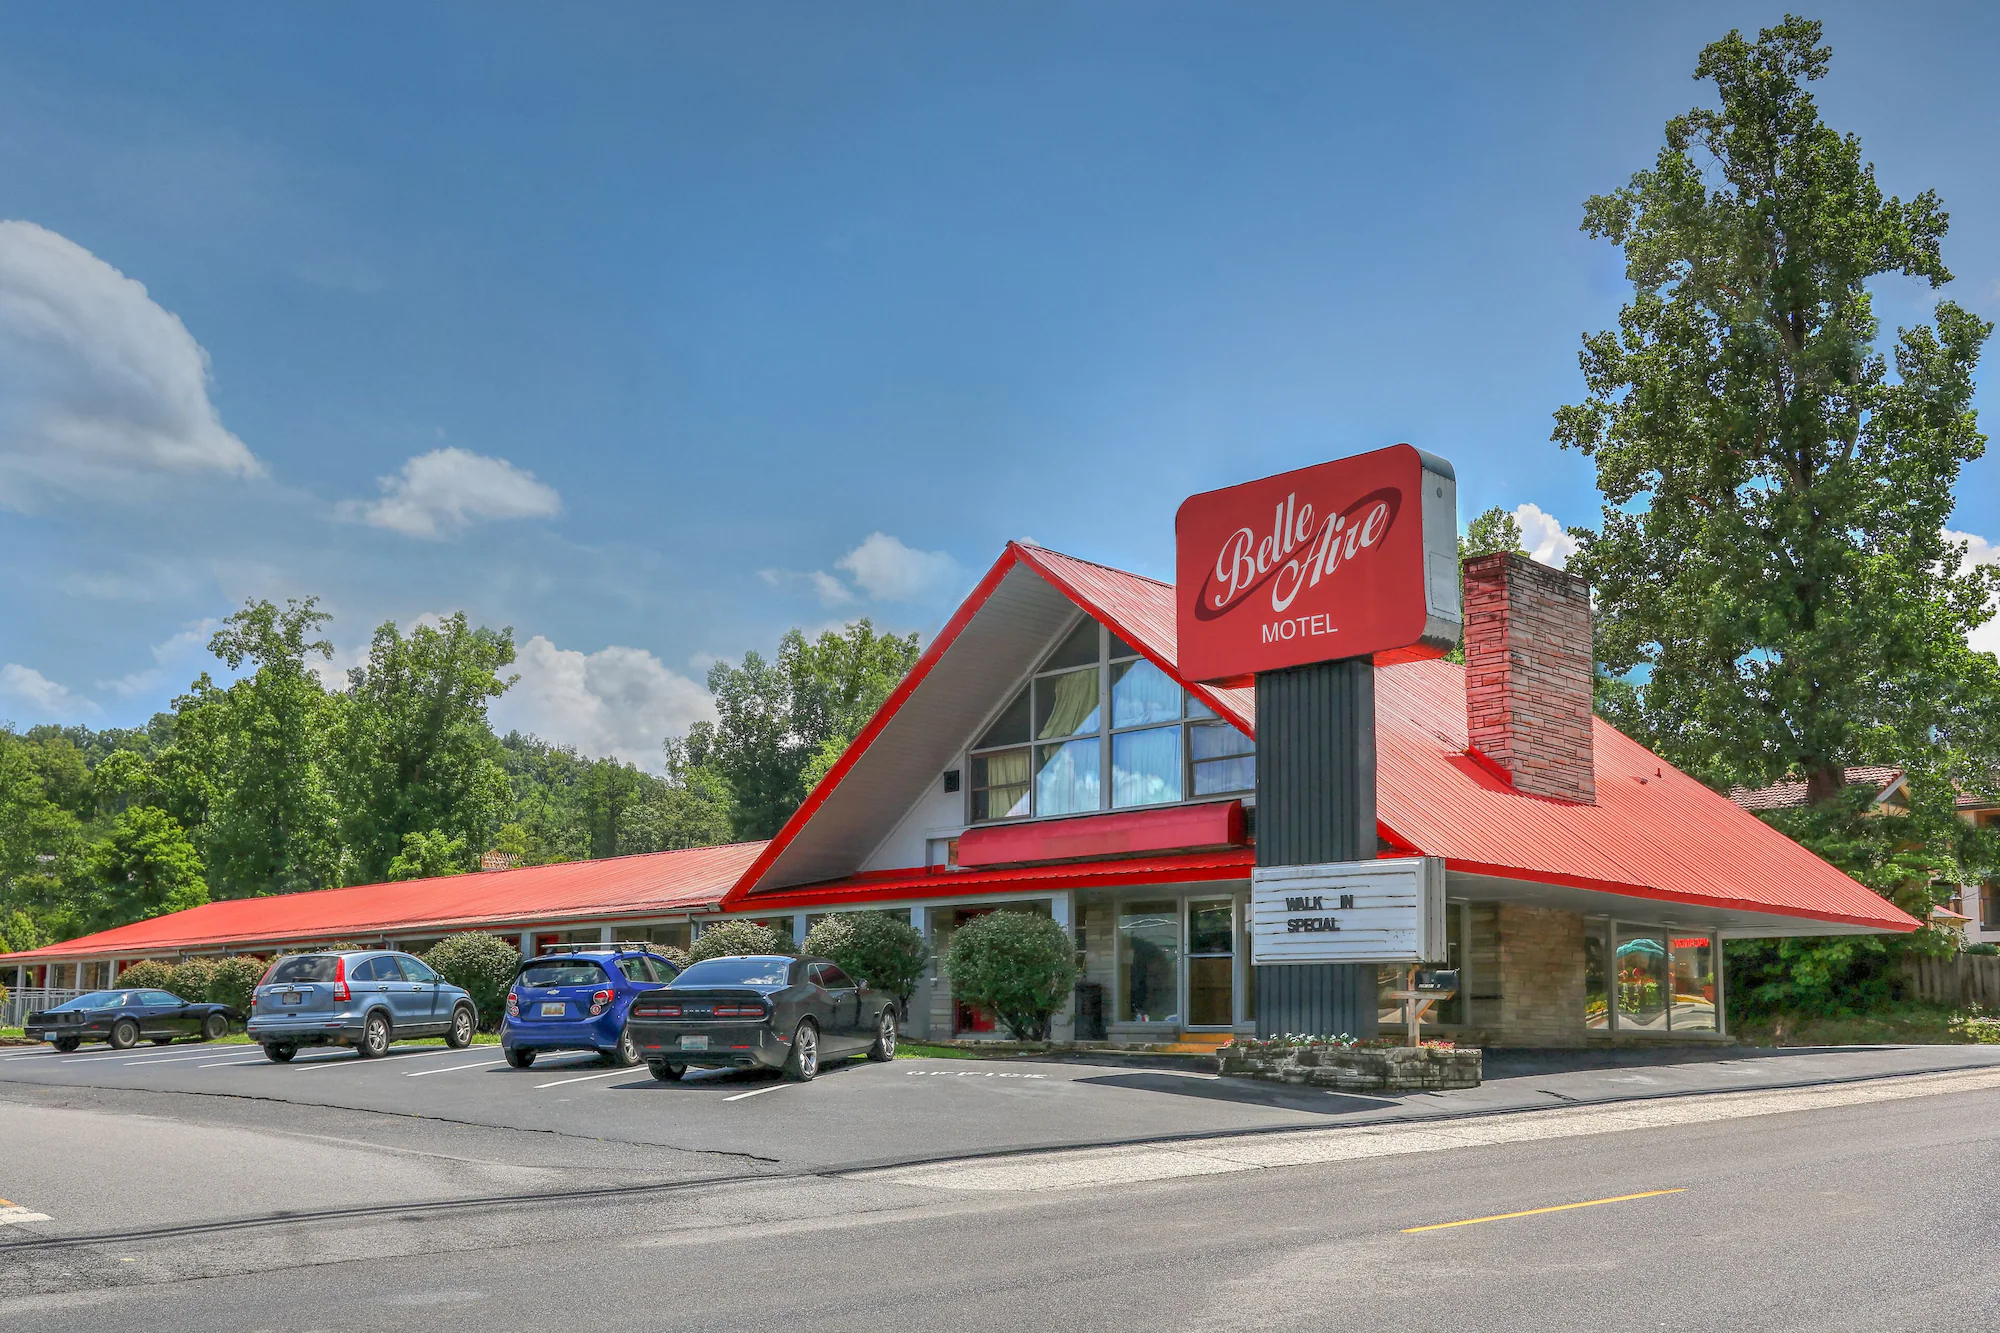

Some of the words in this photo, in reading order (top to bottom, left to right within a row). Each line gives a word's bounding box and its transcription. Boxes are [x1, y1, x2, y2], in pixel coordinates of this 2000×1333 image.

[1214, 492, 1315, 607] Belle
[1271, 503, 1388, 613] Aire
[1262, 613, 1339, 644] MOTEL
[1285, 896, 1323, 911] WALK
[1340, 894, 1354, 909] IN
[1287, 917, 1340, 932] SPECIAL
[906, 1070, 1049, 1079] OFFICE
